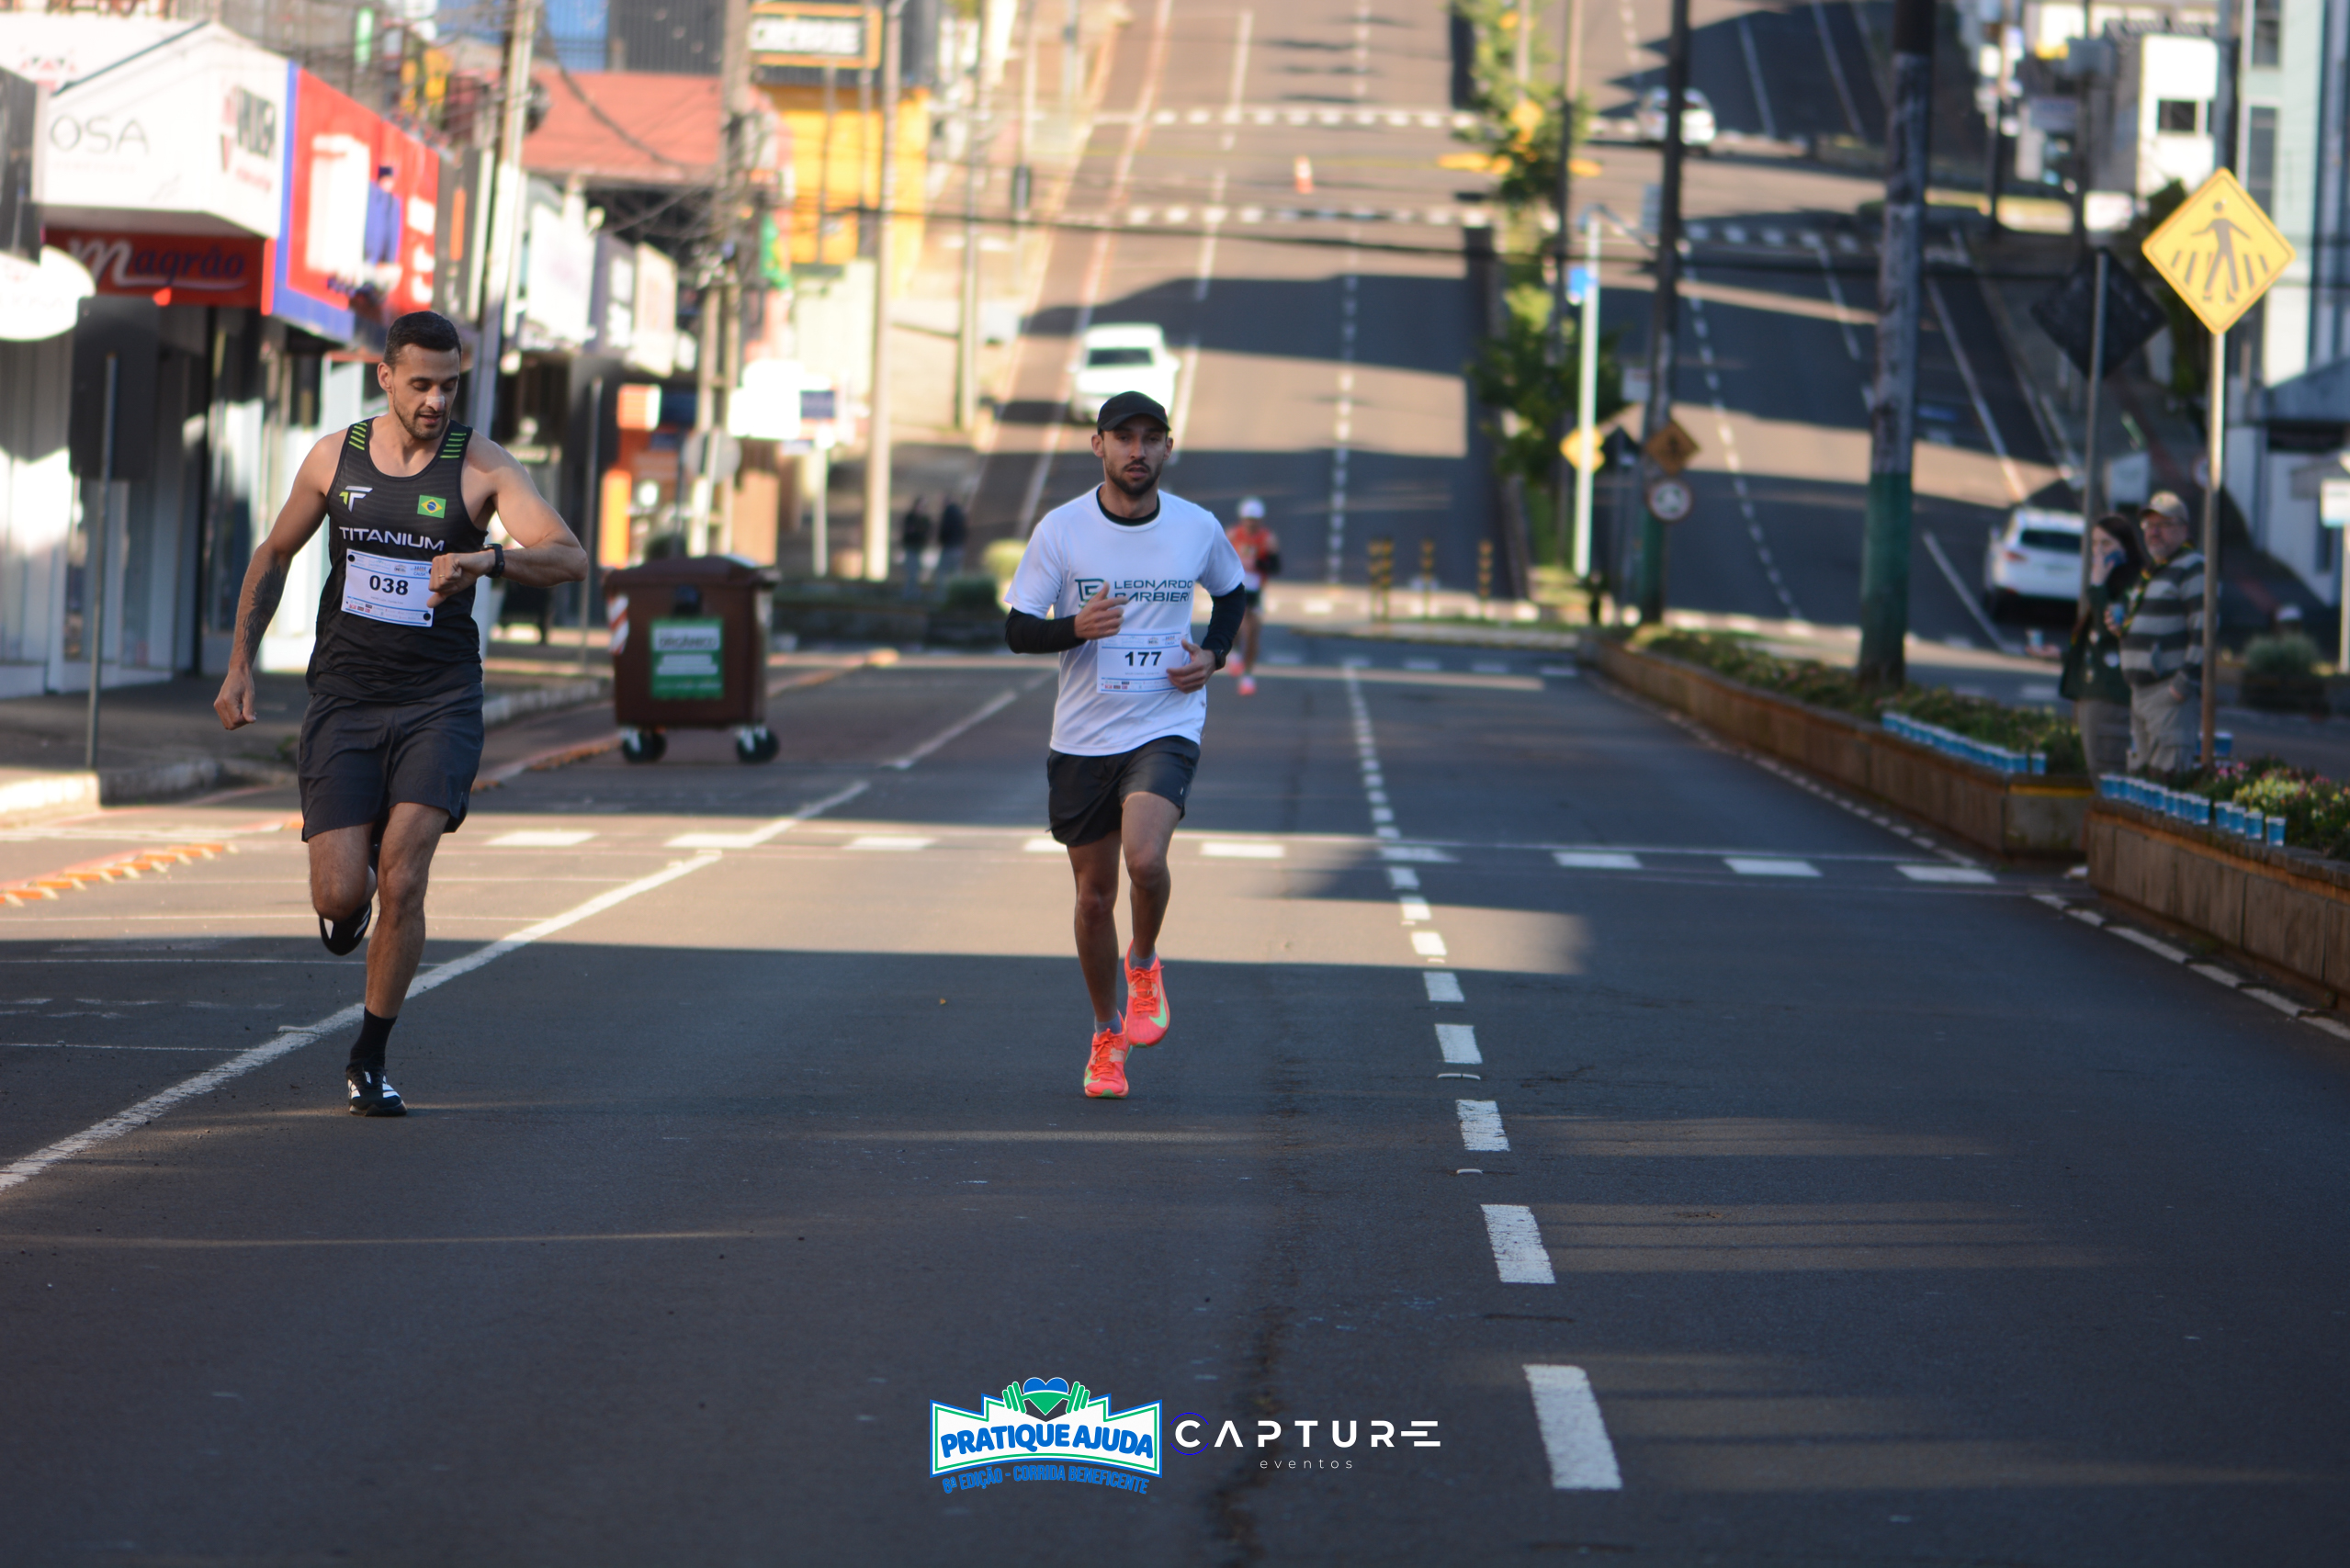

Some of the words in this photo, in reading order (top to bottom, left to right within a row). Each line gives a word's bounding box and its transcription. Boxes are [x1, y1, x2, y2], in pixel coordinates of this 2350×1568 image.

[338, 526, 445, 551] TITANIUM
[369, 575, 409, 596] 038
[1114, 580, 1193, 591] LEONARDO
[1124, 651, 1162, 667] 177
